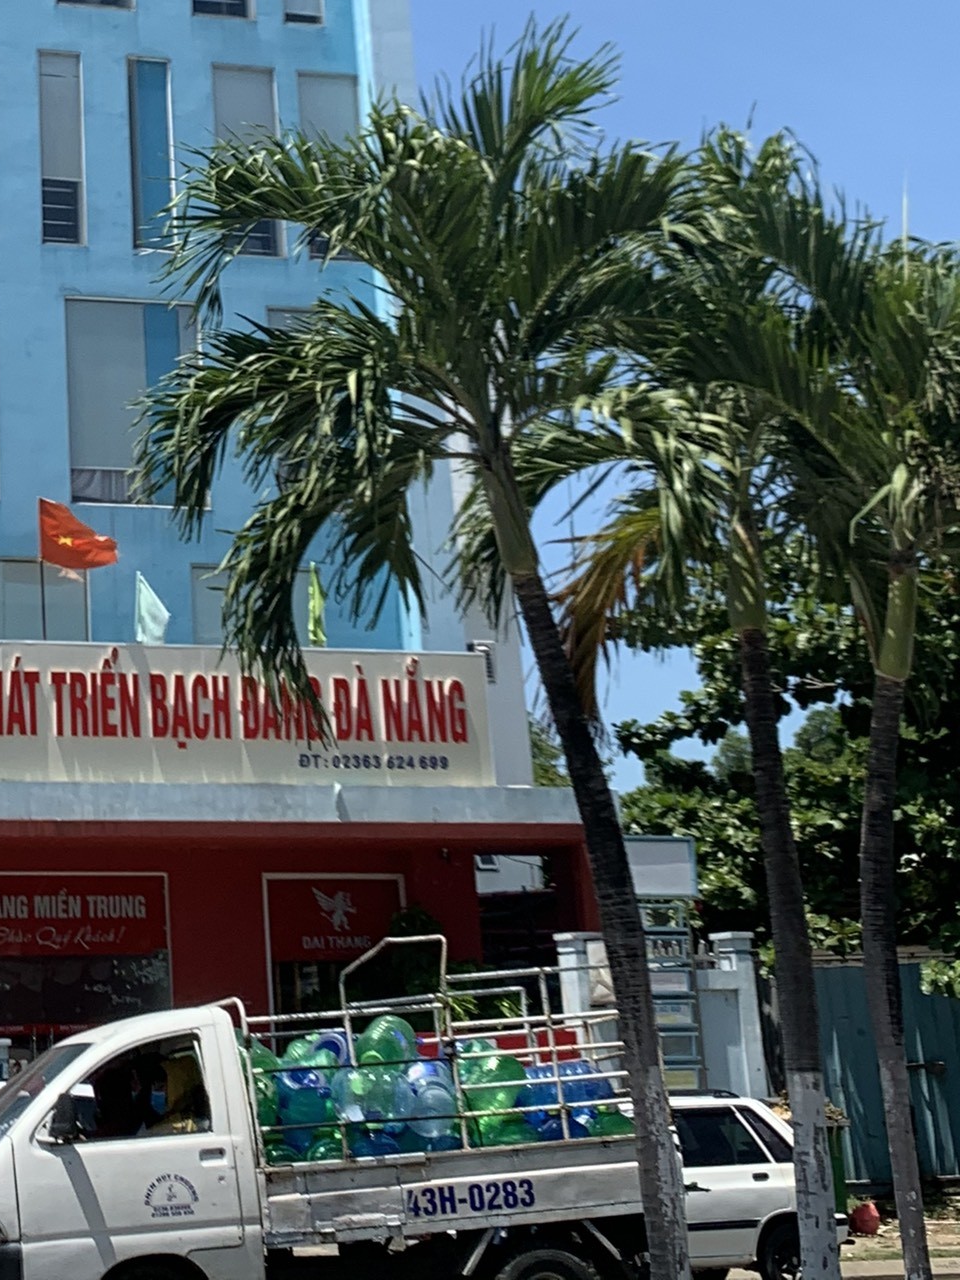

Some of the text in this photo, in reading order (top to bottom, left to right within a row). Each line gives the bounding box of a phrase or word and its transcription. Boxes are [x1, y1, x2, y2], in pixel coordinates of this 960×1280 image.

[50, 647, 141, 739] TRIỂN
[150, 673, 232, 749] BẠCH
[331, 665, 375, 742] ĐÀ
[298, 753, 329, 768] ĐT:
[332, 754, 382, 769] 02363
[386, 754, 415, 769] 624
[86, 895, 146, 918] TRUNG
[407, 1179, 535, 1217] 43H-0283
